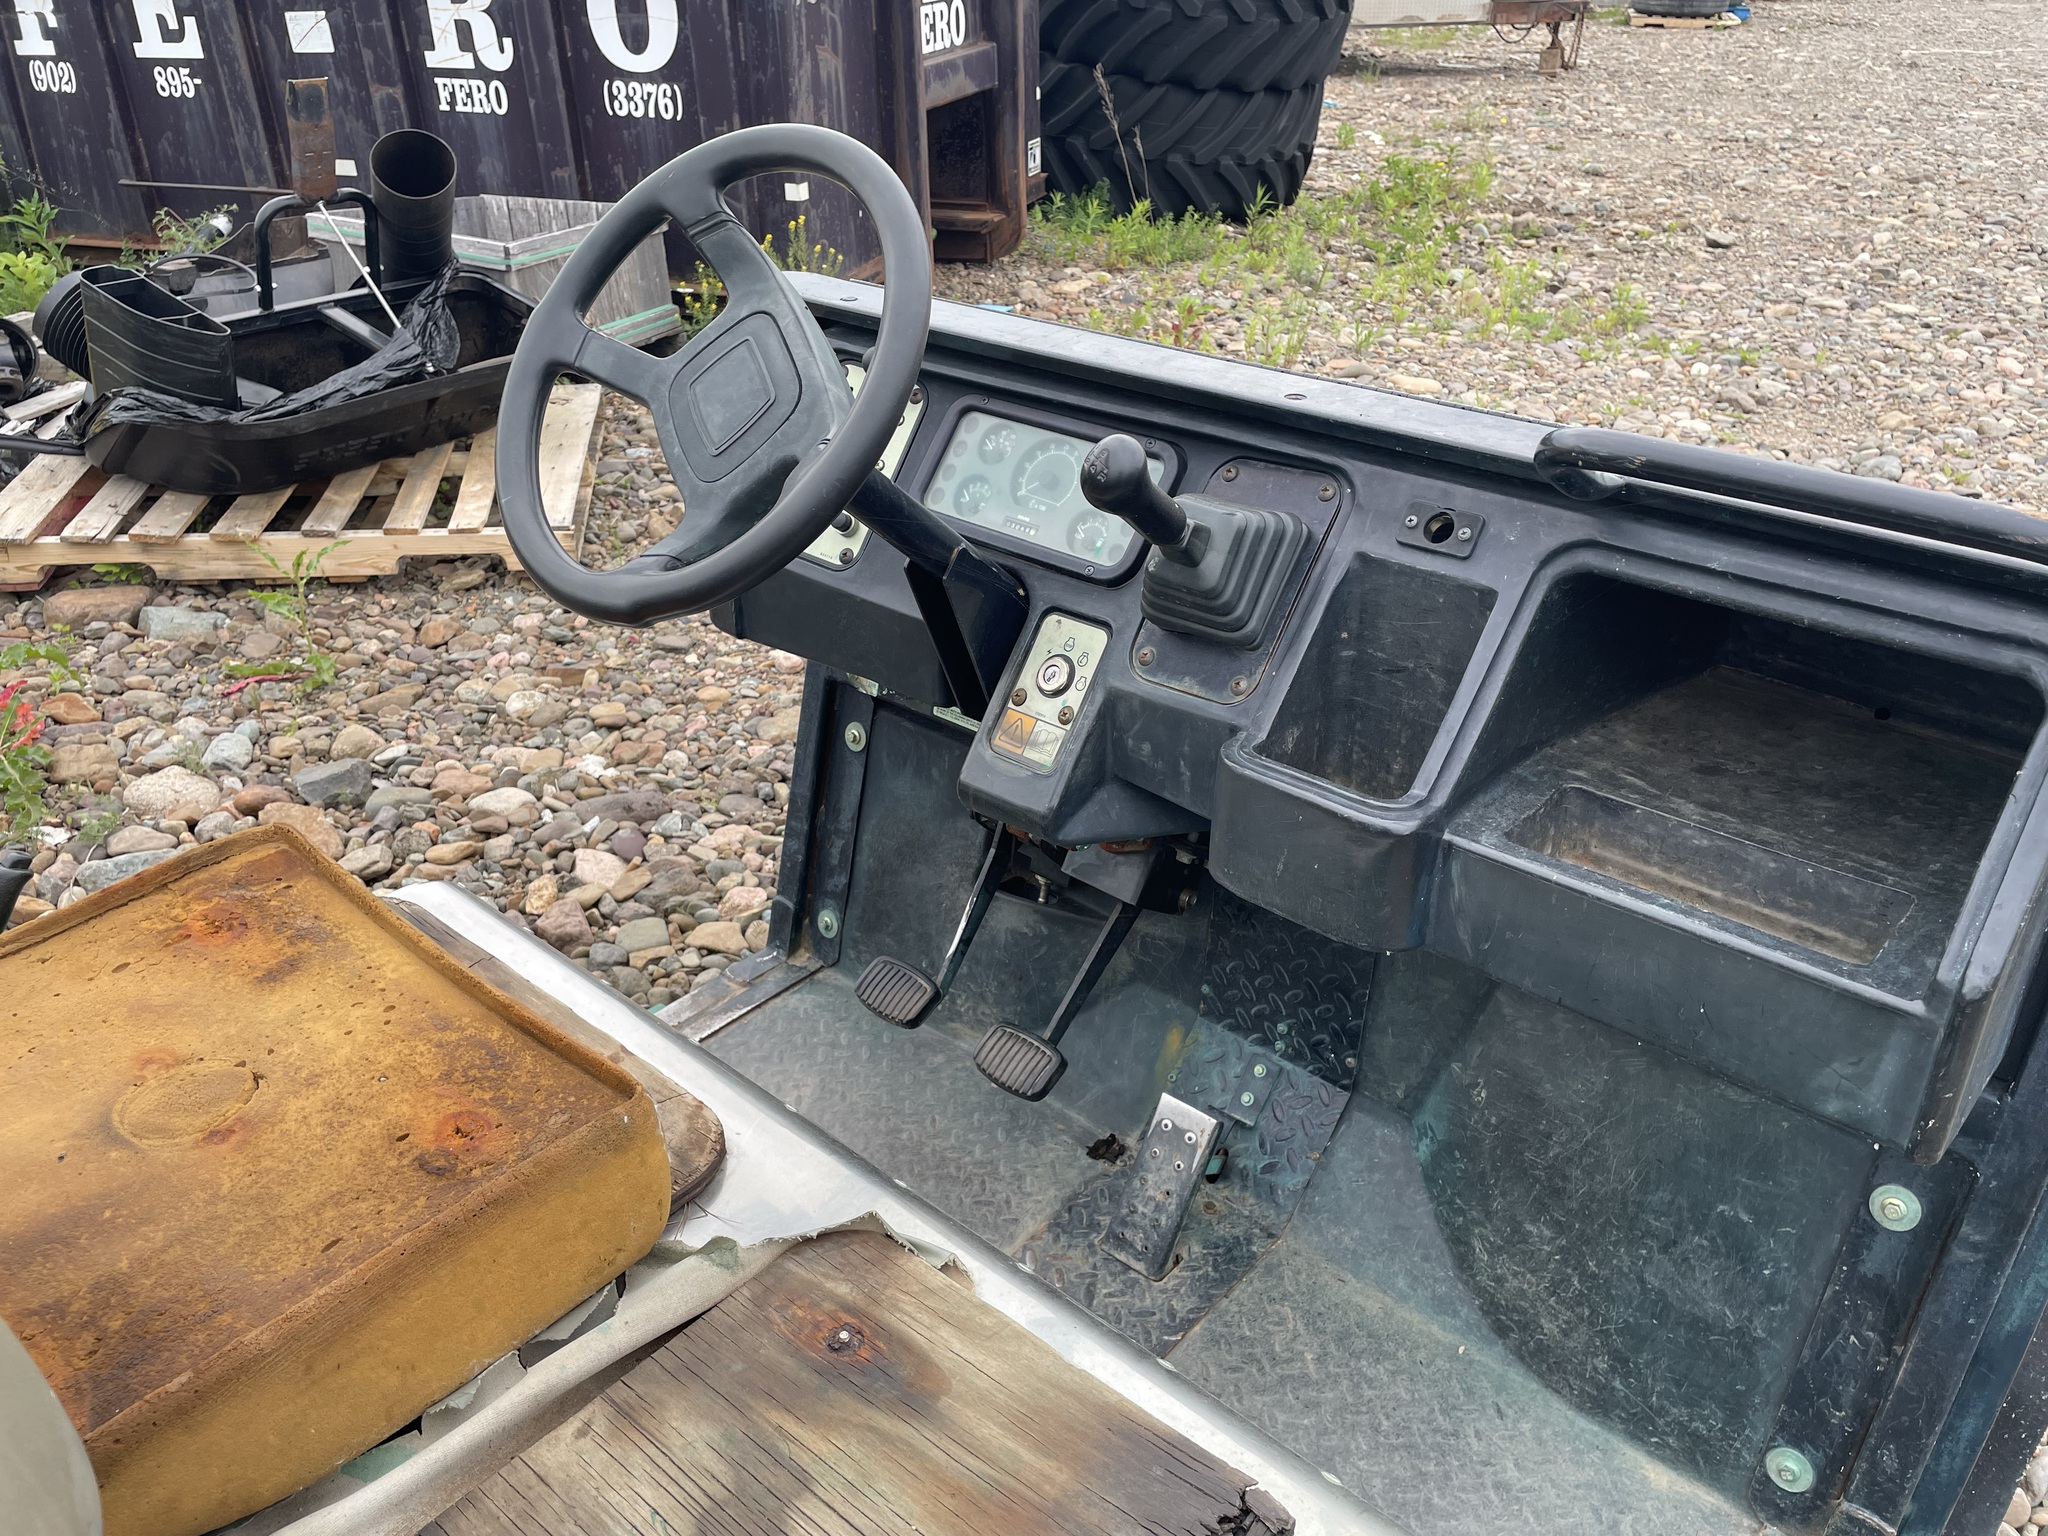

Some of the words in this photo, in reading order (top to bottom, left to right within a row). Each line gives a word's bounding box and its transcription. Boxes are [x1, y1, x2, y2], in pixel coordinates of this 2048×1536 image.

[29, 60, 76, 94] (902)
[434, 77, 509, 116] FERO
[603, 79, 683, 121] (3376)
